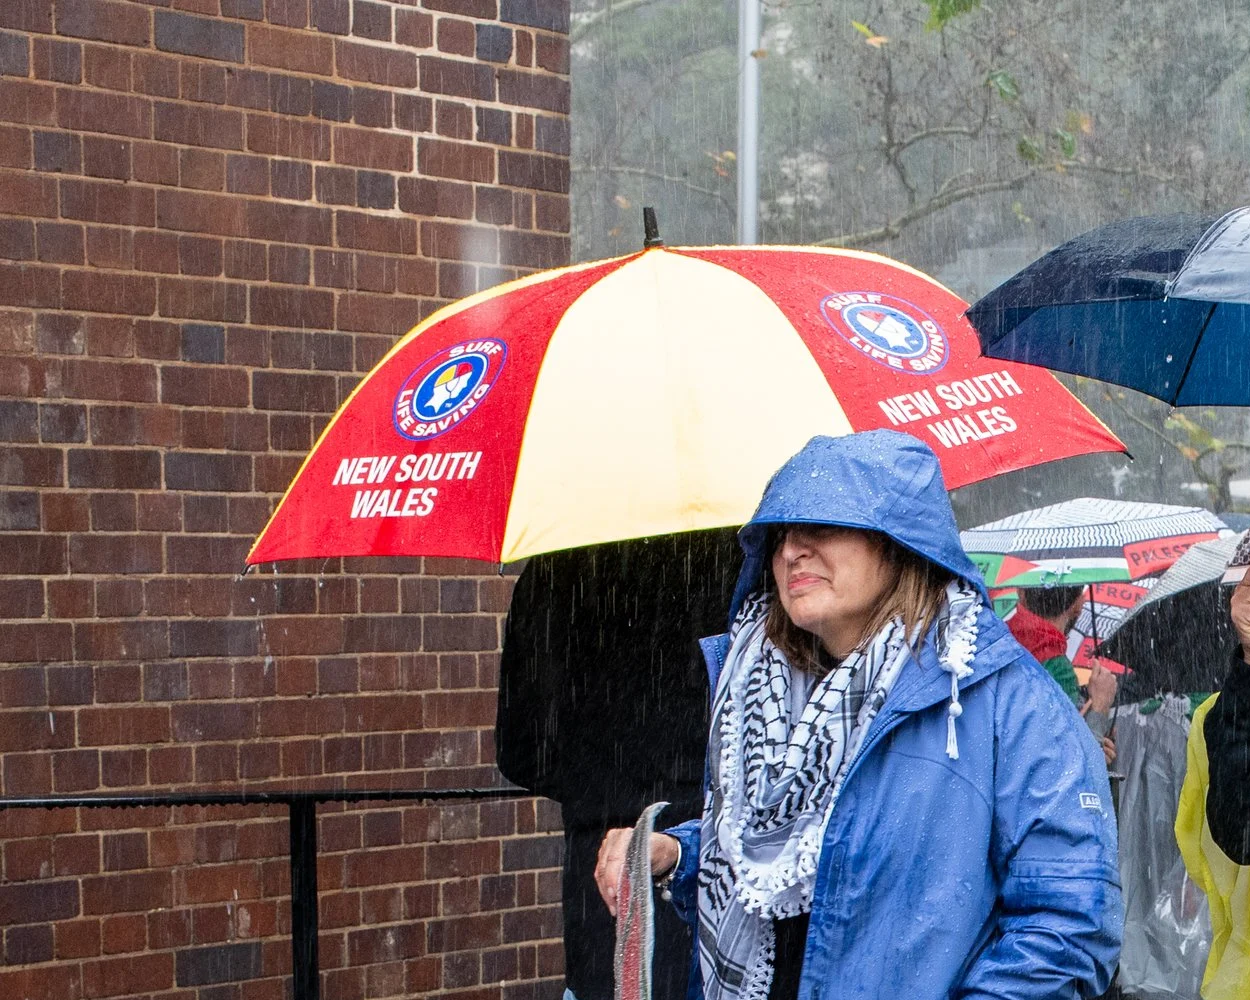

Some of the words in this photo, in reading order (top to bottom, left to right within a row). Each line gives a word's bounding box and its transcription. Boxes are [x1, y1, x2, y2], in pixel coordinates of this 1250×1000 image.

[826, 294, 881, 311] SURF
[449, 341, 502, 357] SURF
[849, 336, 904, 370] LIFE
[908, 320, 944, 371] SAVING
[397, 389, 414, 431] LIFE
[412, 383, 490, 436] SAVING
[878, 389, 941, 426] NEW
[935, 370, 1023, 410] SOUTH
[926, 406, 1018, 448] WALES
[332, 456, 397, 485] NEW
[394, 451, 482, 482] SOUTH
[350, 487, 438, 518] WALES
